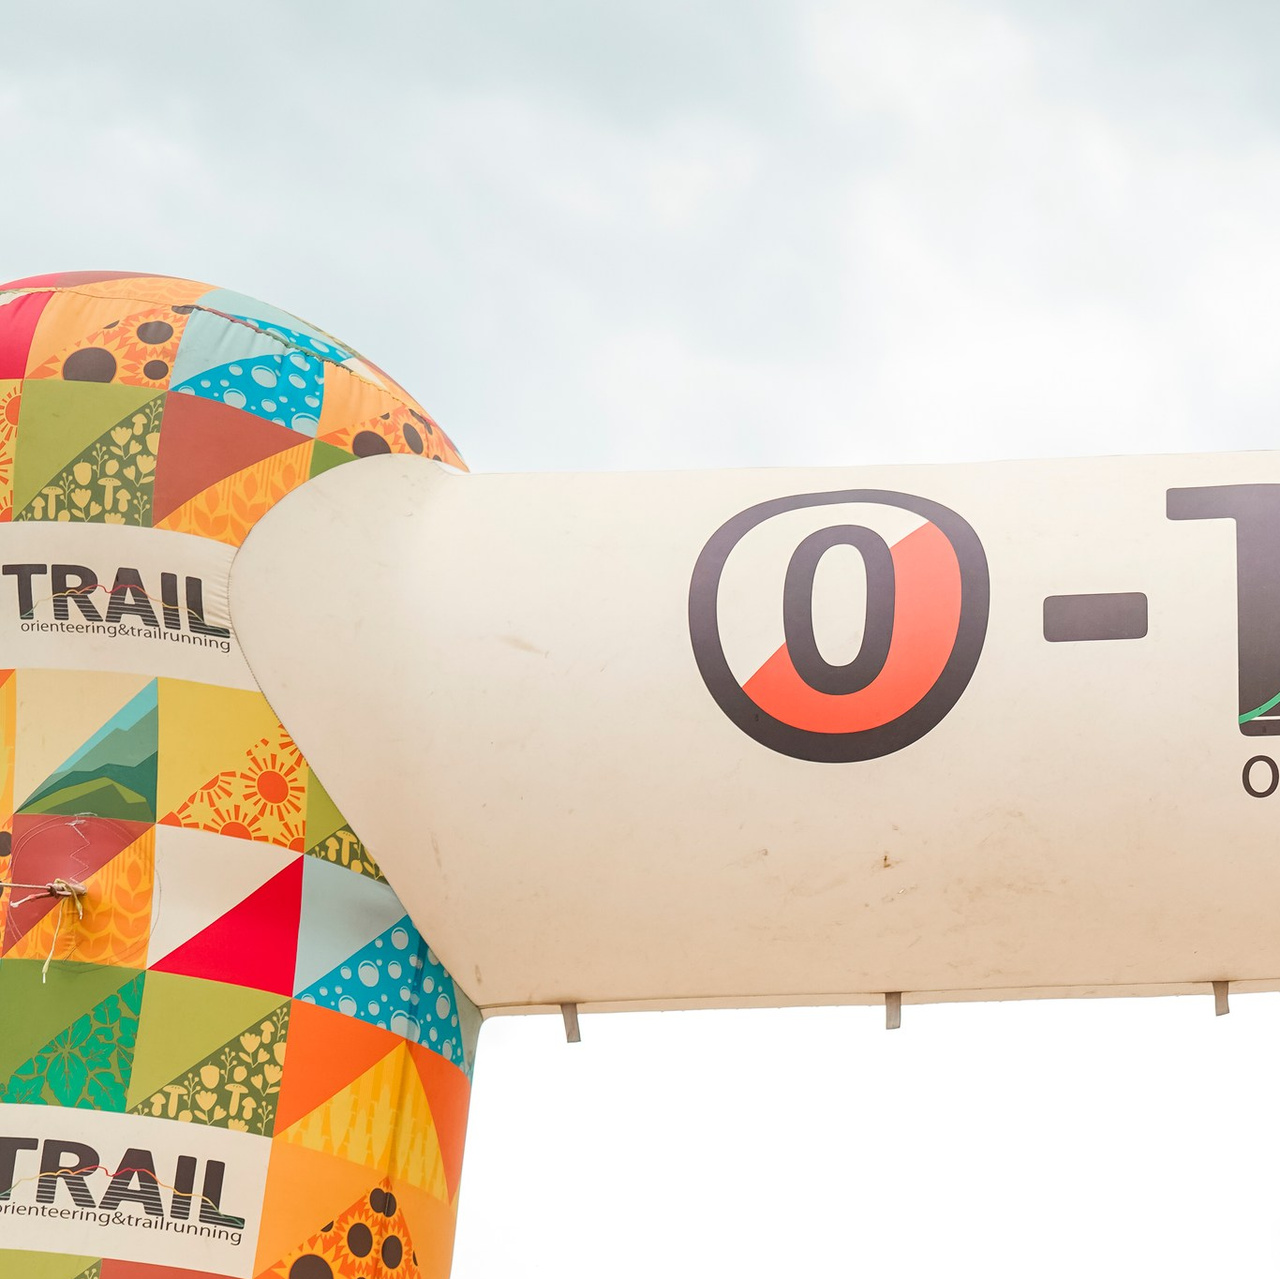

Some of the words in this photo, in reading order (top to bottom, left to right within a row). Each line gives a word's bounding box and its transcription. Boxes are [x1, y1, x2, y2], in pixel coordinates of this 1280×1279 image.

[2, 563, 231, 638] TRAIL
[20, 619, 231, 653] orienteering&trailrunning
[0, 1136, 245, 1229] TRAIL
